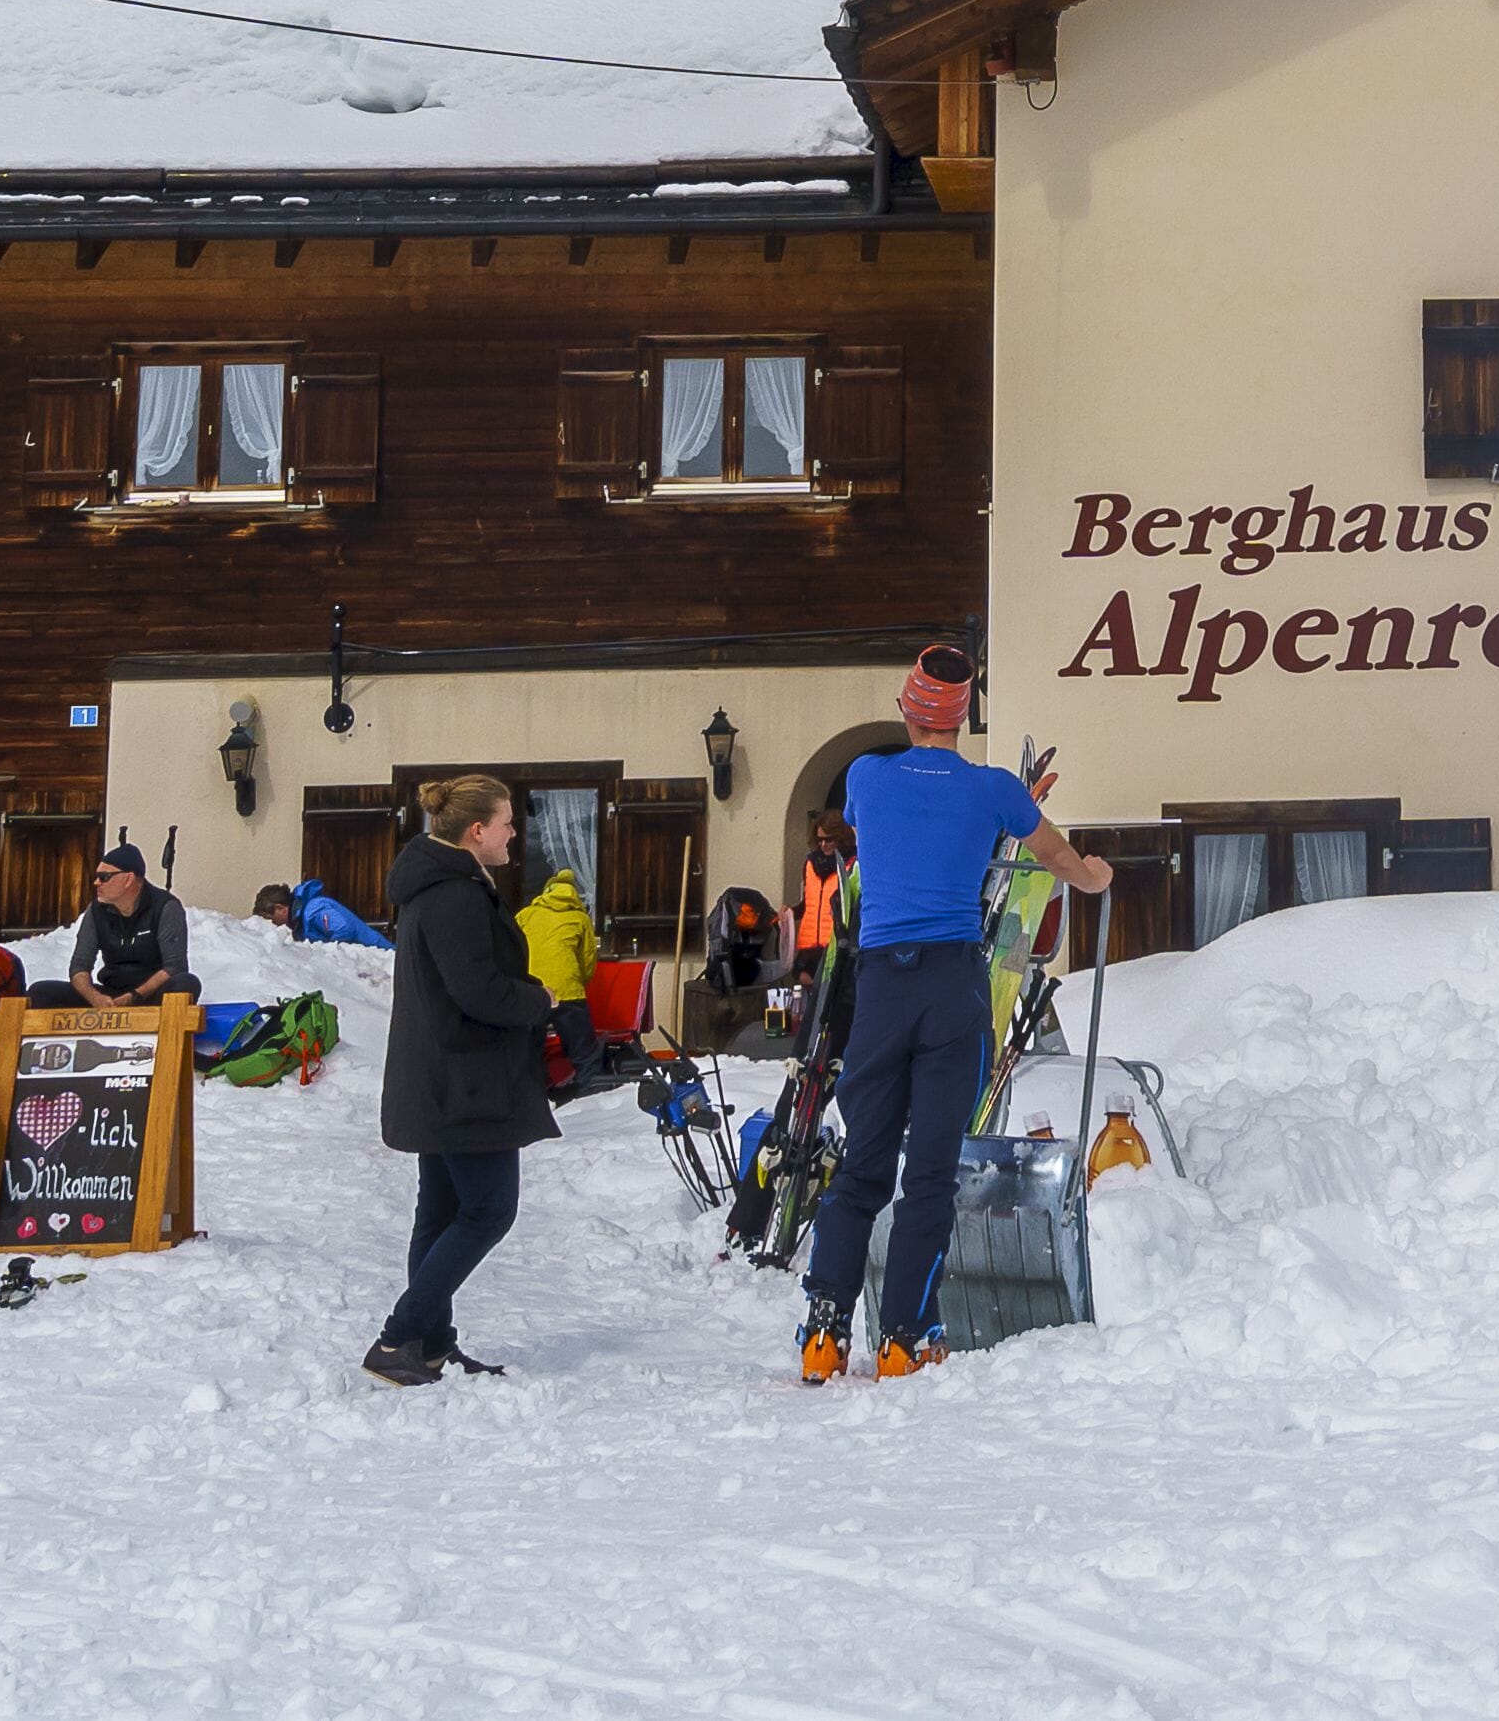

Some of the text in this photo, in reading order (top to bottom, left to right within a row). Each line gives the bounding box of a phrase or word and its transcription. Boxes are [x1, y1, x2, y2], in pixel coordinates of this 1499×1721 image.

[1061, 484, 1492, 576] Berghaus
[82, 708, 88, 724] 1
[52, 1009, 131, 1031] MÖHL
[5, 1157, 134, 1201] Willkommen
